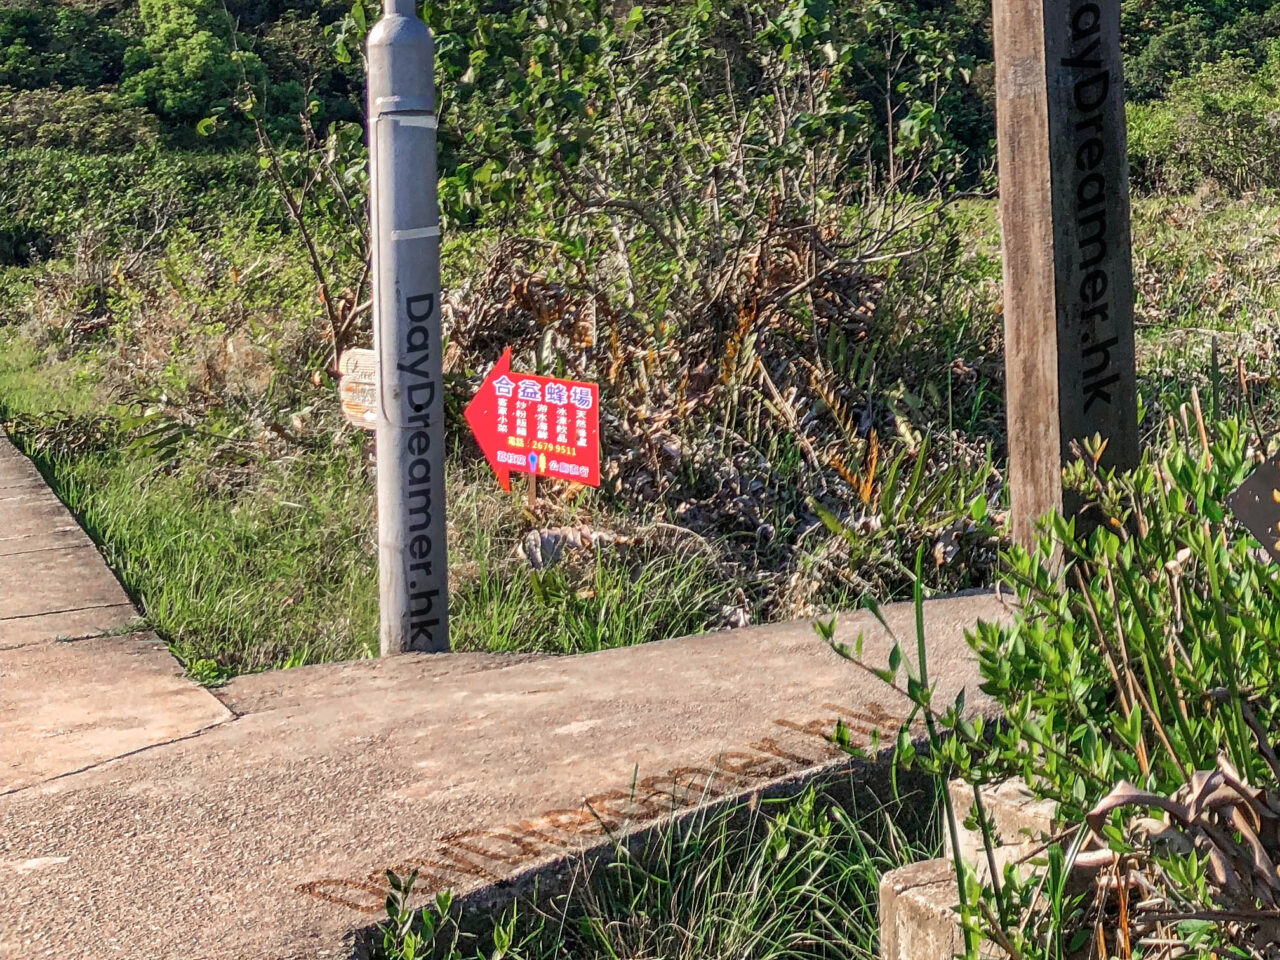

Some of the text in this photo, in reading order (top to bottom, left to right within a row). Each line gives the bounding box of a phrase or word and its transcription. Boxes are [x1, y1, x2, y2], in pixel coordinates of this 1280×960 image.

[493, 375, 593, 410] 合益蜂場
[532, 440, 554, 452] 2679
[555, 445, 577, 456] 9511
